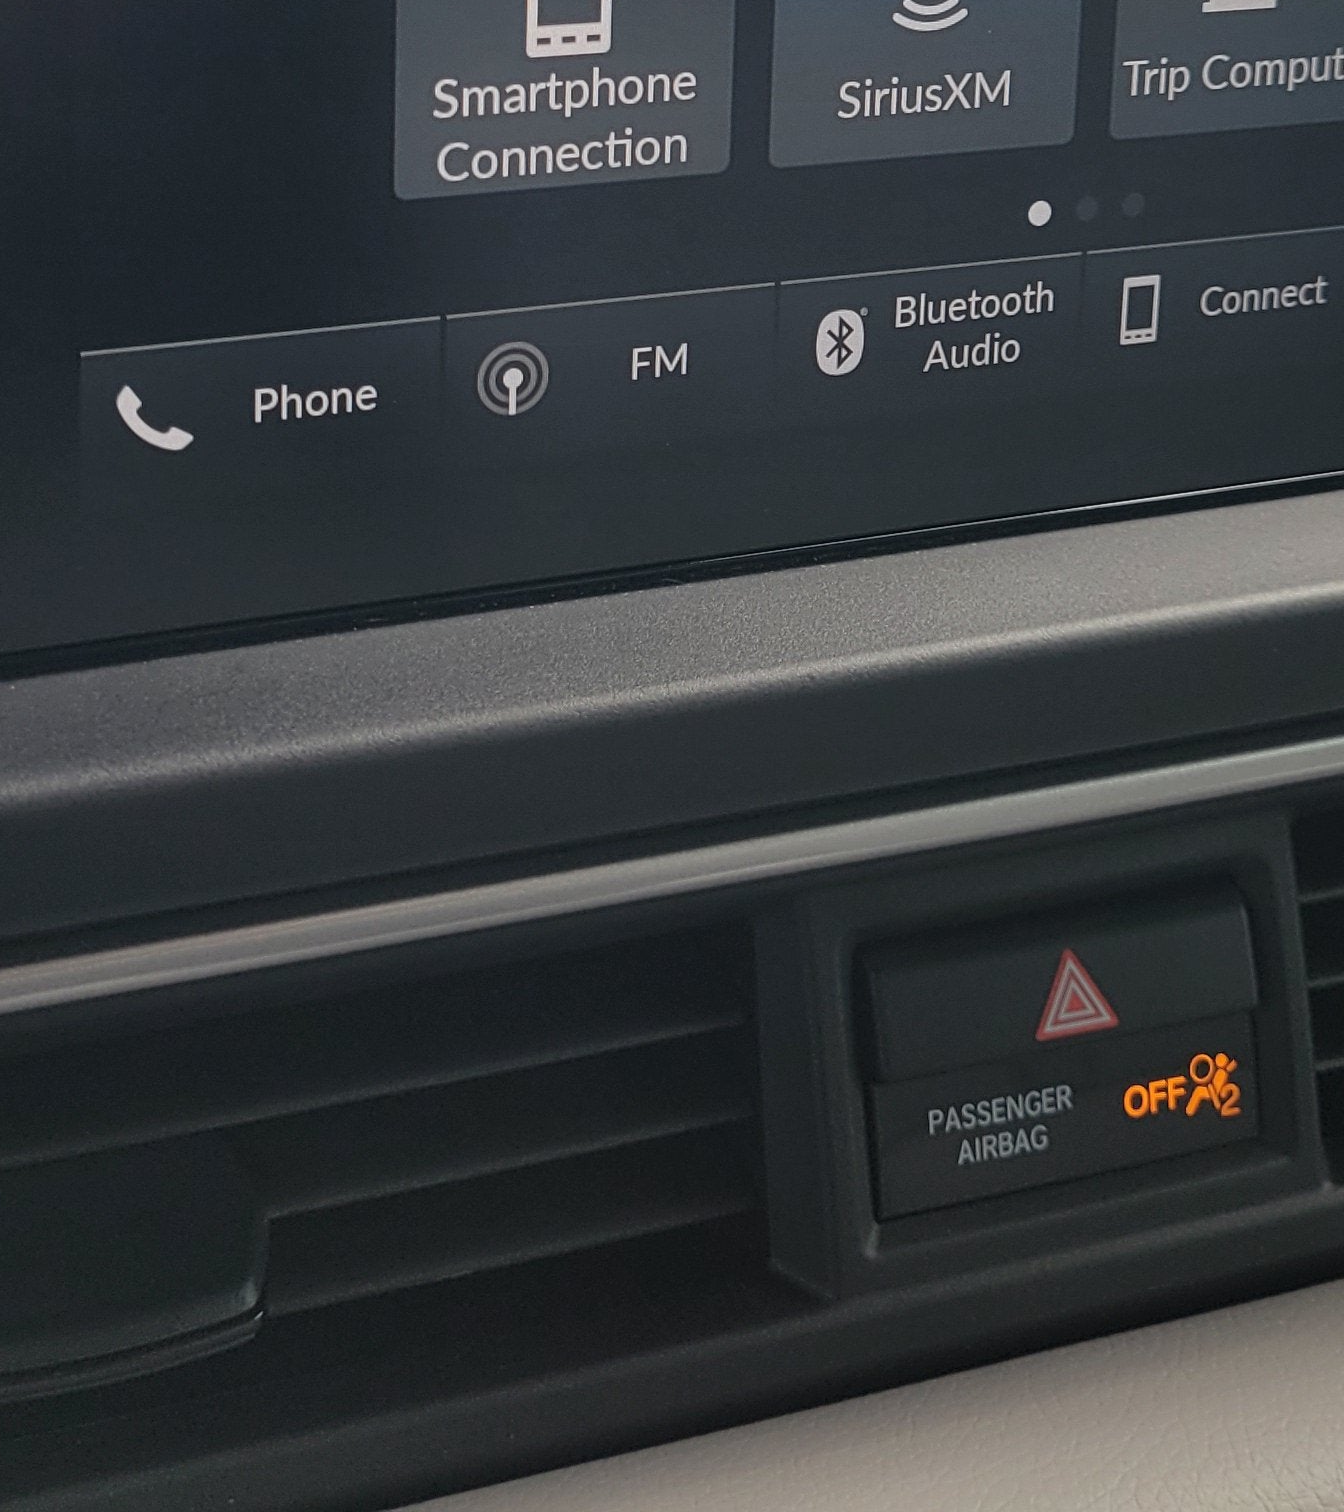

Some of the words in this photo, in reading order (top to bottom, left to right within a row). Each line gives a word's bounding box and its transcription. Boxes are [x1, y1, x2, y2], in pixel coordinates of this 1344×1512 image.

[432, 66, 697, 119] Smartphone
[837, 69, 1011, 120] SiriusXM
[1123, 59, 1190, 101] Trip
[437, 128, 688, 183] Connection
[894, 281, 1058, 329] Bluetooth
[1200, 276, 1327, 318] Connect
[630, 343, 689, 381] FM
[923, 330, 1022, 374] Audio
[253, 381, 378, 424] Phone
[928, 1085, 1074, 1136] PASSENGER
[1123, 1075, 1186, 1118] OFF
[957, 1124, 1049, 1166] AIRBAG
